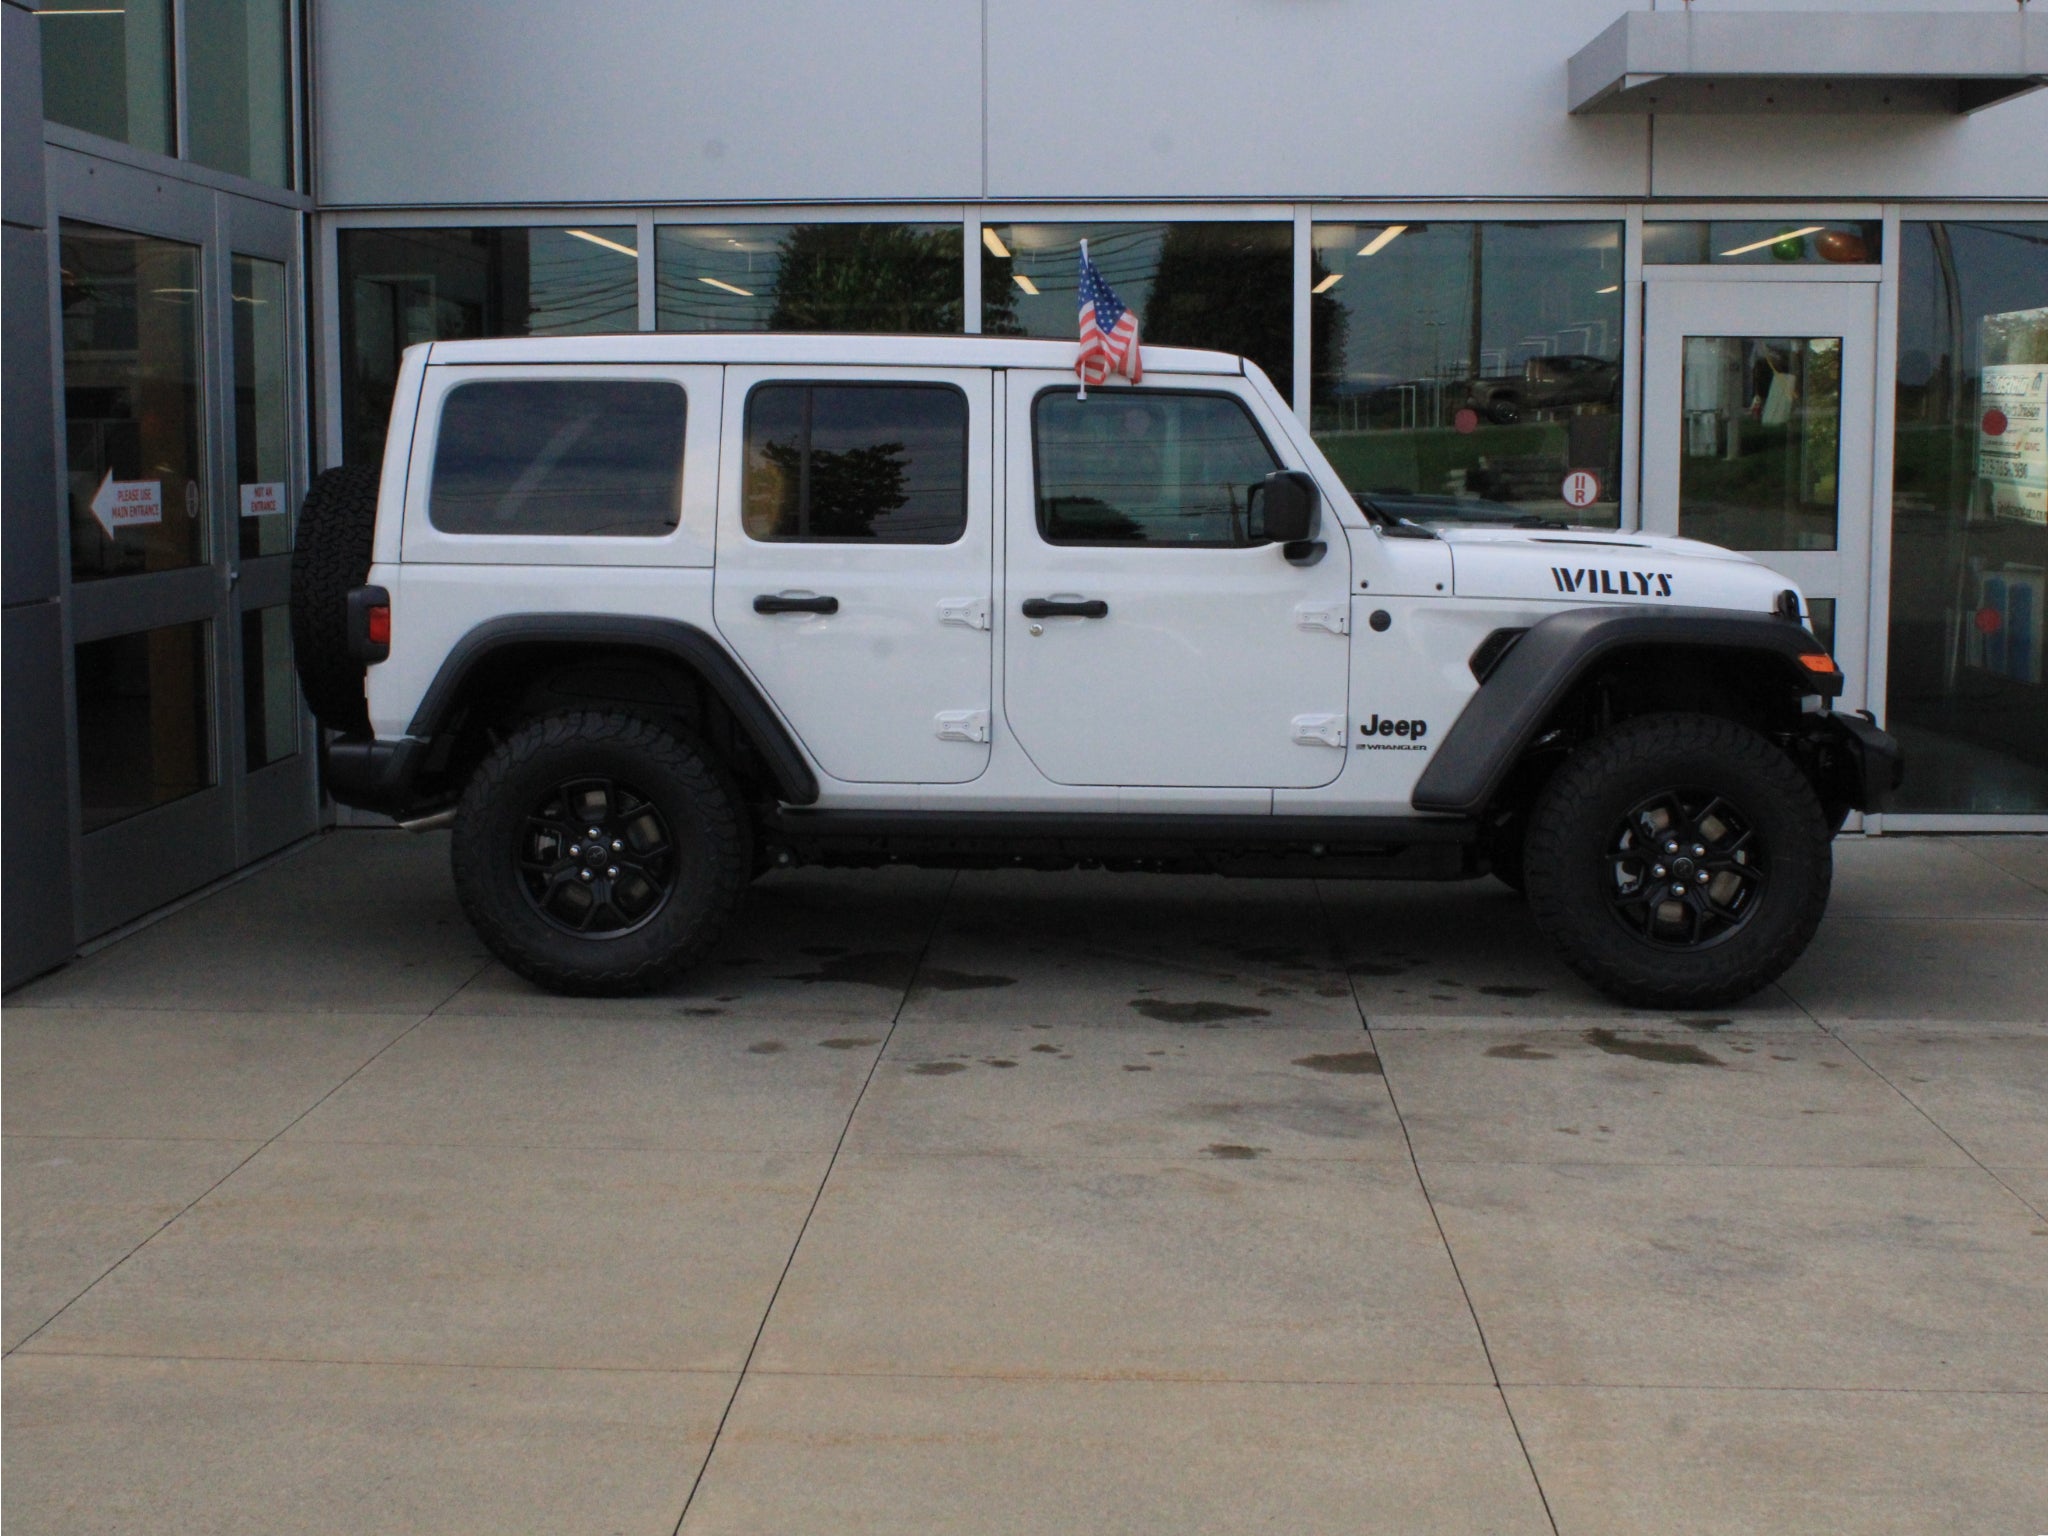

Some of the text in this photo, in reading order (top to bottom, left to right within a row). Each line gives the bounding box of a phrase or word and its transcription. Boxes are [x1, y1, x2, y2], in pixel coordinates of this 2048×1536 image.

[117, 488, 152, 502] PLEASE USE
[254, 487, 264, 498] NOT
[112, 504, 159, 519] MAIN ENTRANCE
[251, 501, 276, 512] ENTRANCE
[1551, 567, 1673, 597] WILLYS
[1360, 714, 1427, 741] Jeep
[1366, 743, 1427, 751] WRANGLER
